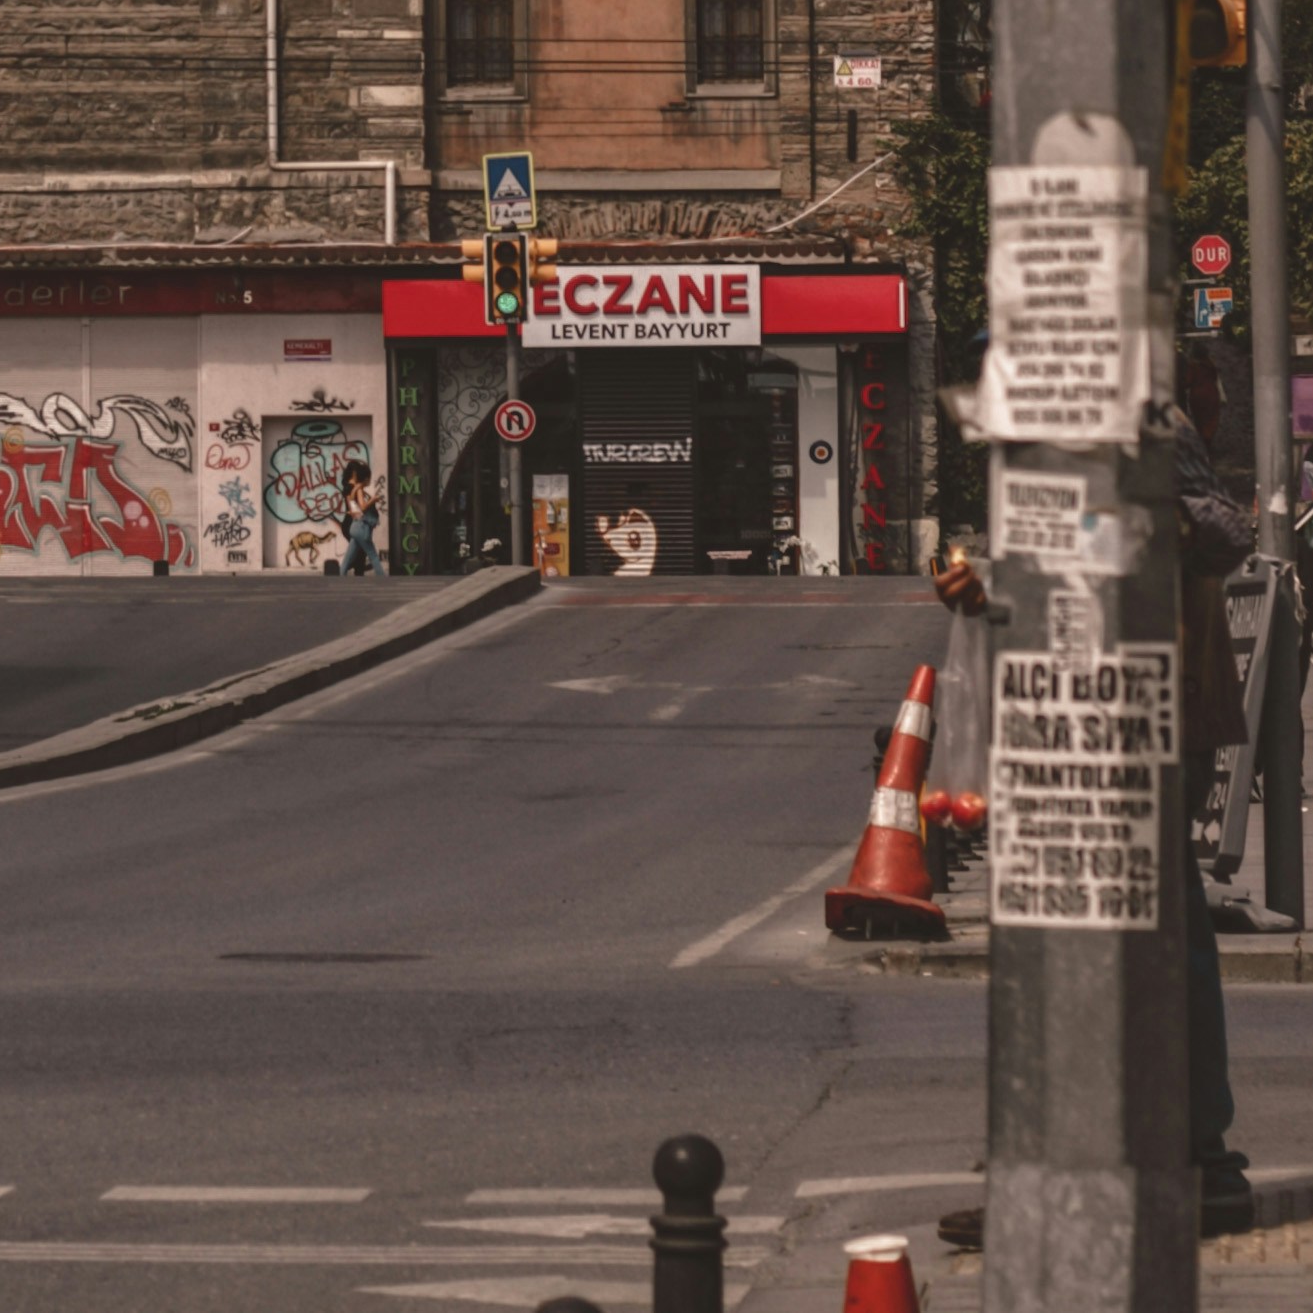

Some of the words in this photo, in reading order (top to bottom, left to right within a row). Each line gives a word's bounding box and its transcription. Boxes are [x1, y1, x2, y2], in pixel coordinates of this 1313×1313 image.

[1195, 247, 1228, 263] DUR
[533, 273, 750, 315] ECZANE
[551, 323, 630, 342] LEVENT
[634, 322, 731, 341] BAYYURT
[397, 357, 423, 576] PHARMACY
[860, 351, 887, 570] ECZANE
